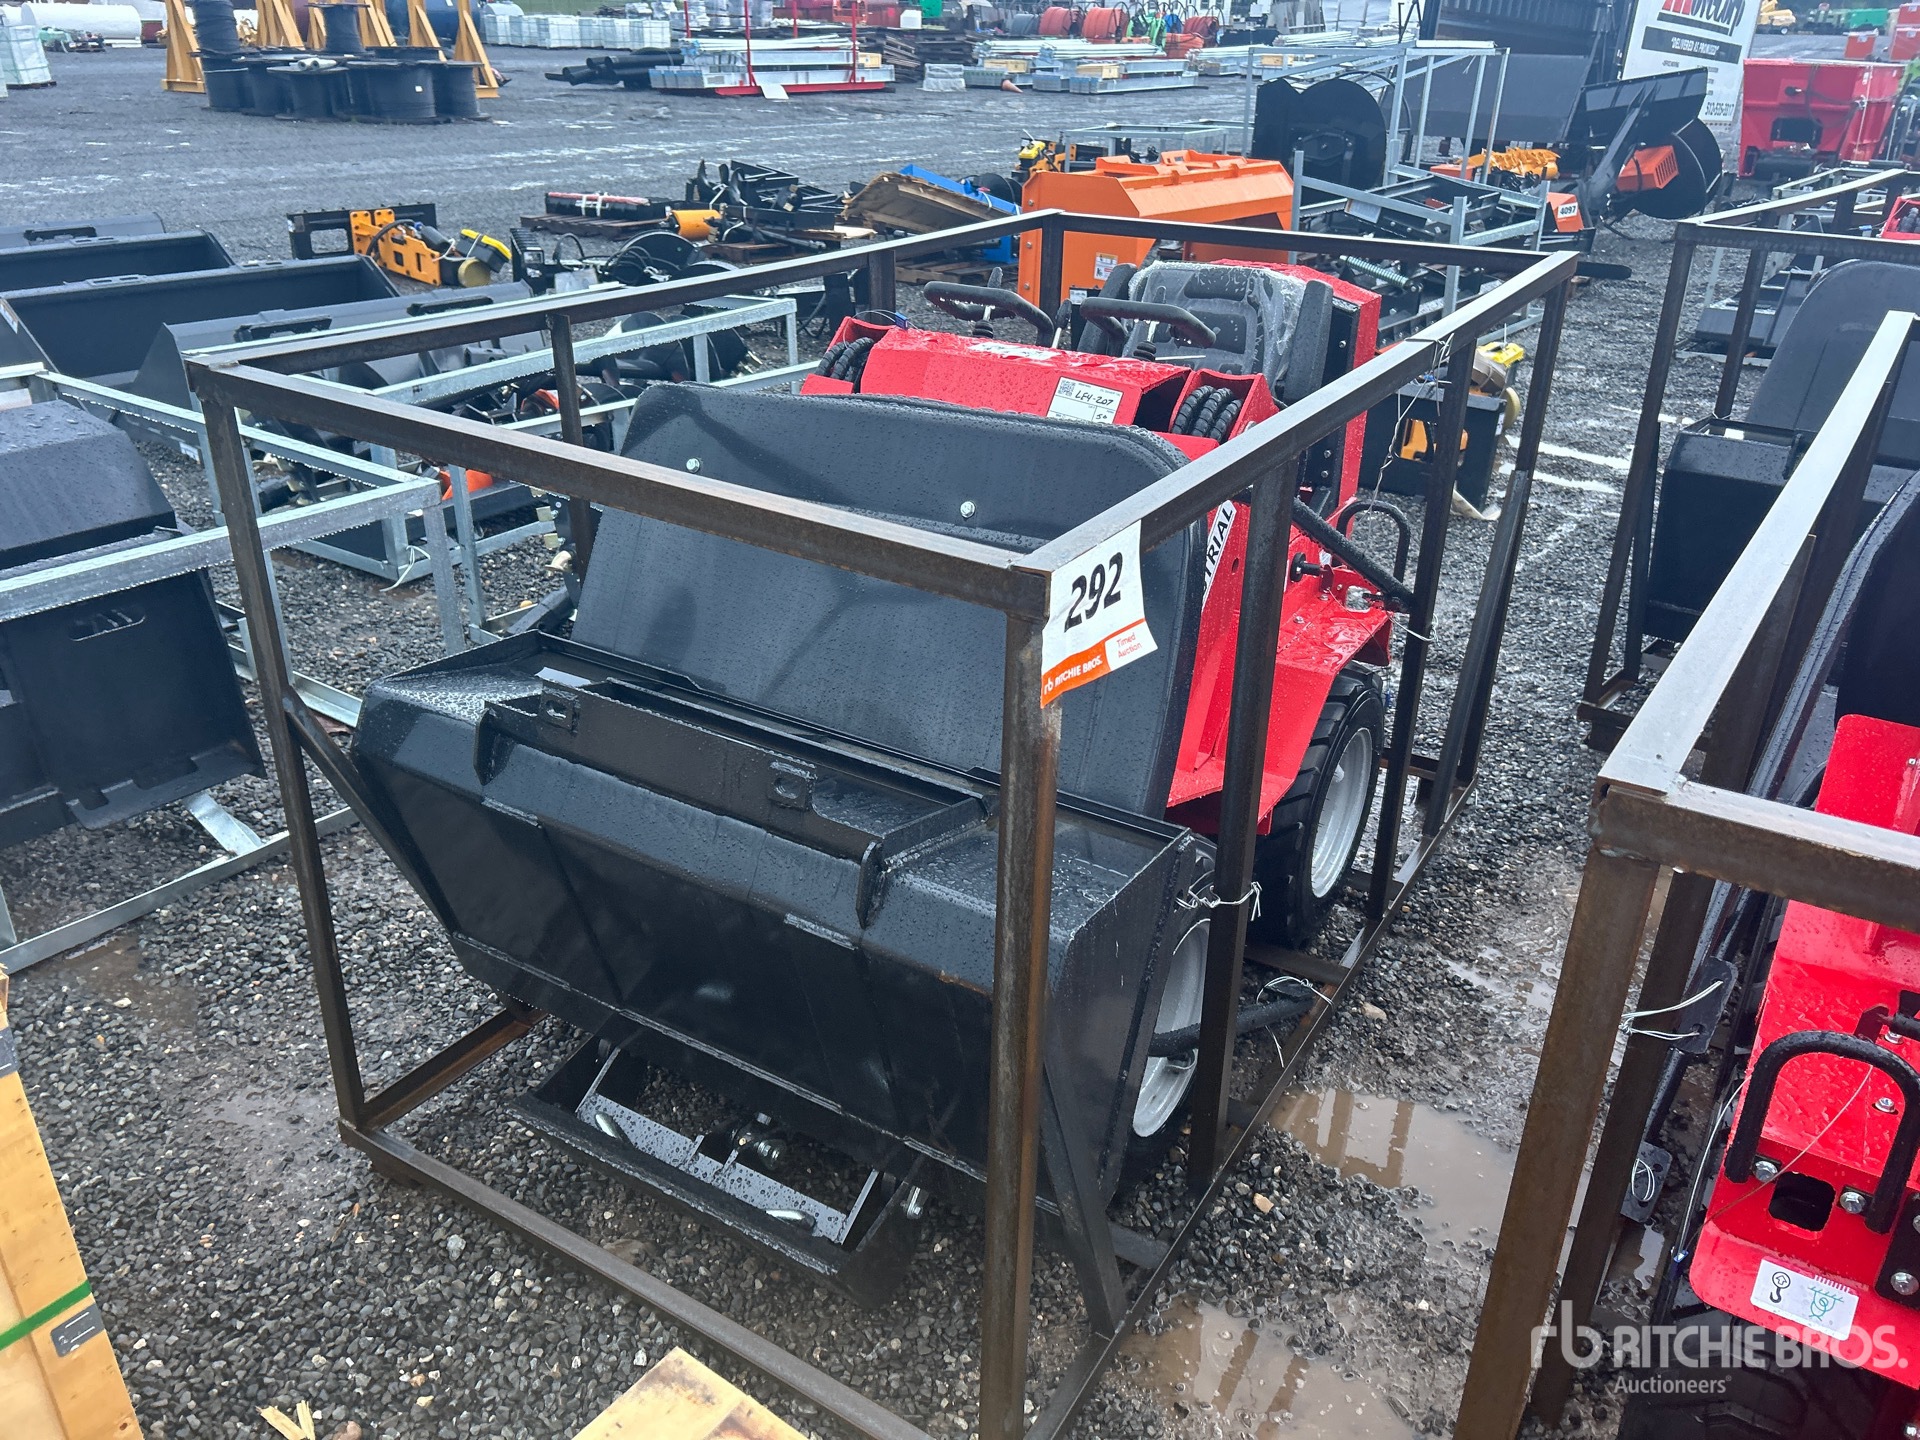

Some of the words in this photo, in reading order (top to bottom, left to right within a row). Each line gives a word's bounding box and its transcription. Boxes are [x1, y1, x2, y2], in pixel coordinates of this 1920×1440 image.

[1560, 205, 1577, 215] 4097
[1064, 552, 1123, 633] 292
[1116, 632, 1136, 648] Timed
[1118, 642, 1143, 658] Auction
[1054, 665, 1081, 687] RITCHIE
[1083, 655, 1103, 674] BROS.
